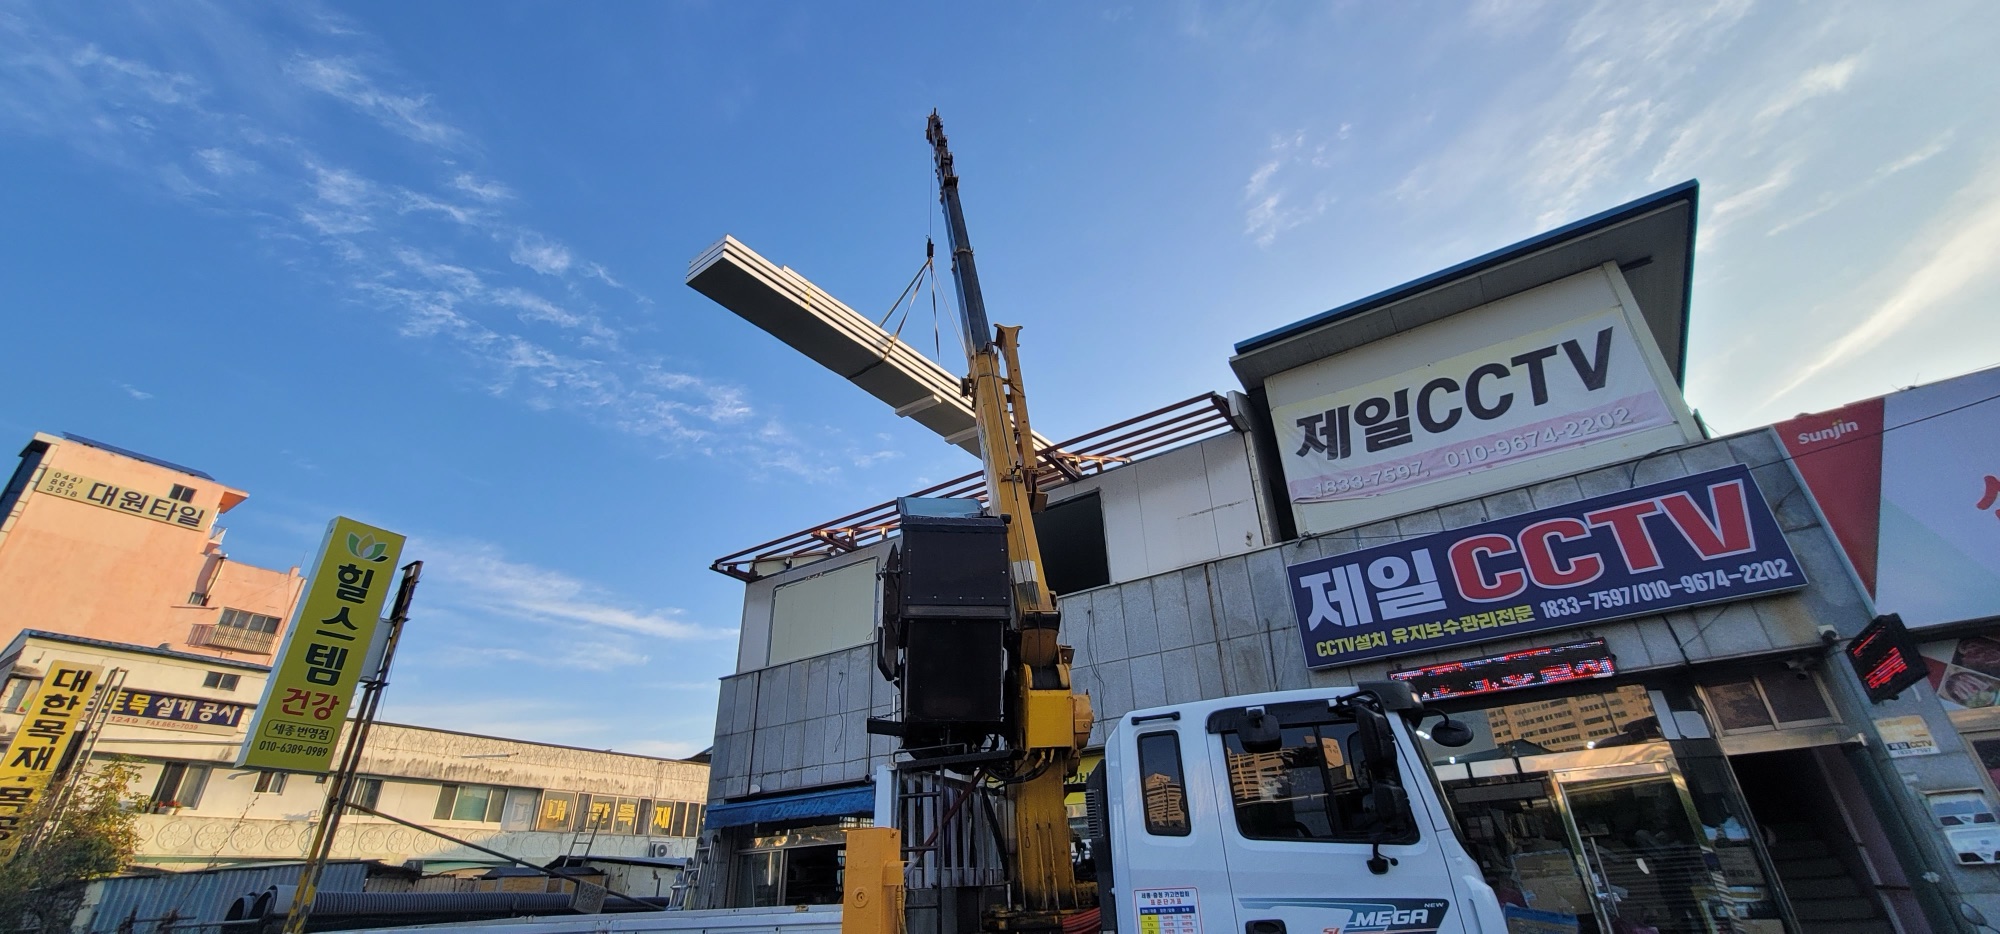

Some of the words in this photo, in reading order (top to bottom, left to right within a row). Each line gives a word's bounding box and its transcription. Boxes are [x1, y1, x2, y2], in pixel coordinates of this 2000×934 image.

[1445, 406, 1634, 468] 010-9674-2202
[46, 486, 78, 498] 3518
[50, 478, 74, 490] 865
[87, 482, 205, 528] 대원타일
[305, 563, 375, 687] 힐스템
[1315, 633, 1389, 658] CCTV설치
[1391, 604, 1536, 645] 유지보수관리전문
[281, 688, 341, 721] 건강
[271, 723, 297, 737] 세종
[297, 726, 331, 741] 번영점
[258, 740, 329, 758] 010-6389-0989
[1909, 740, 1933, 749] CCTV
[1355, 909, 1429, 927] MEGA
